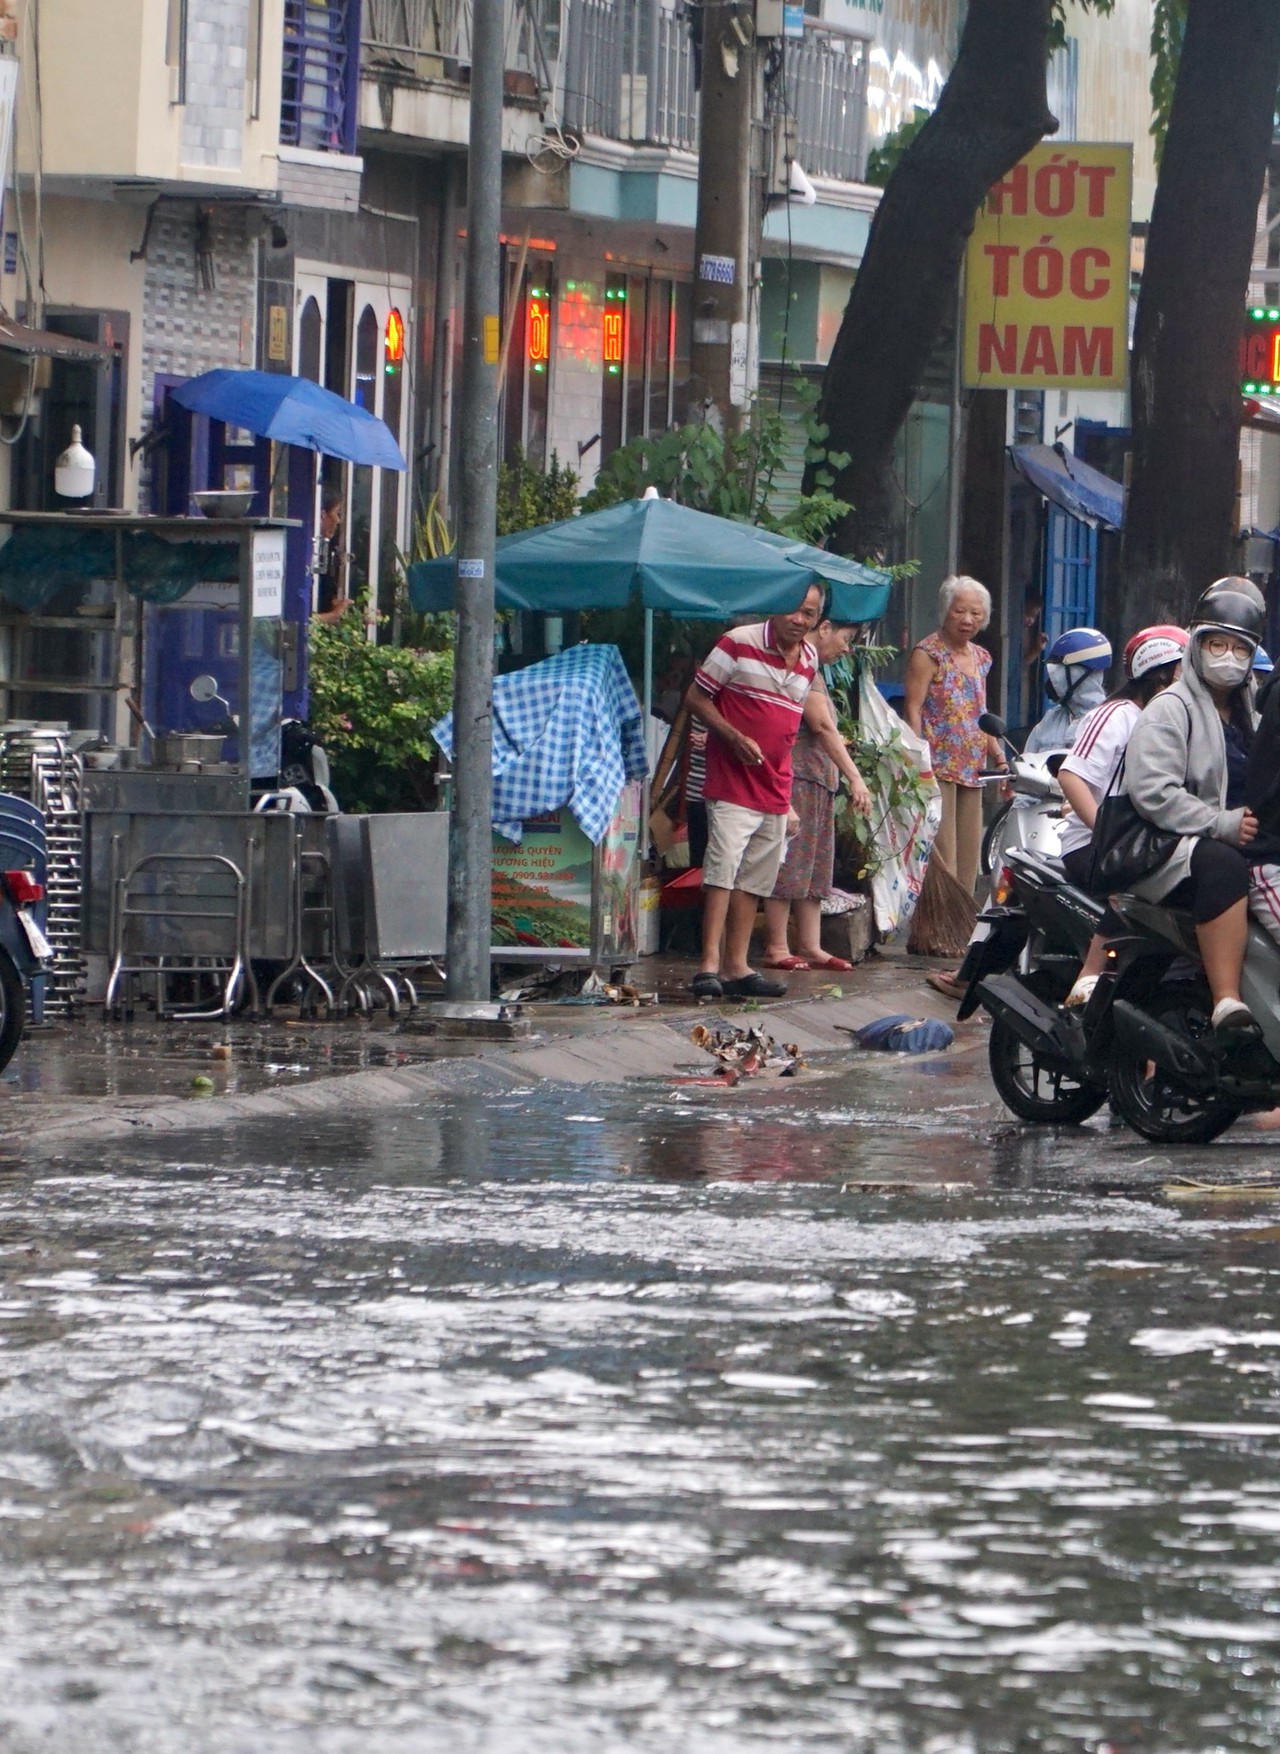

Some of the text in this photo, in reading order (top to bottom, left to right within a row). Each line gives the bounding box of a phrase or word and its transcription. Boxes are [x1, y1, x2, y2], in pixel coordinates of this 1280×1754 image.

[986, 154, 1116, 218] HỚT
[983, 235, 1111, 301] TÓC
[978, 323, 1115, 377] NAM
